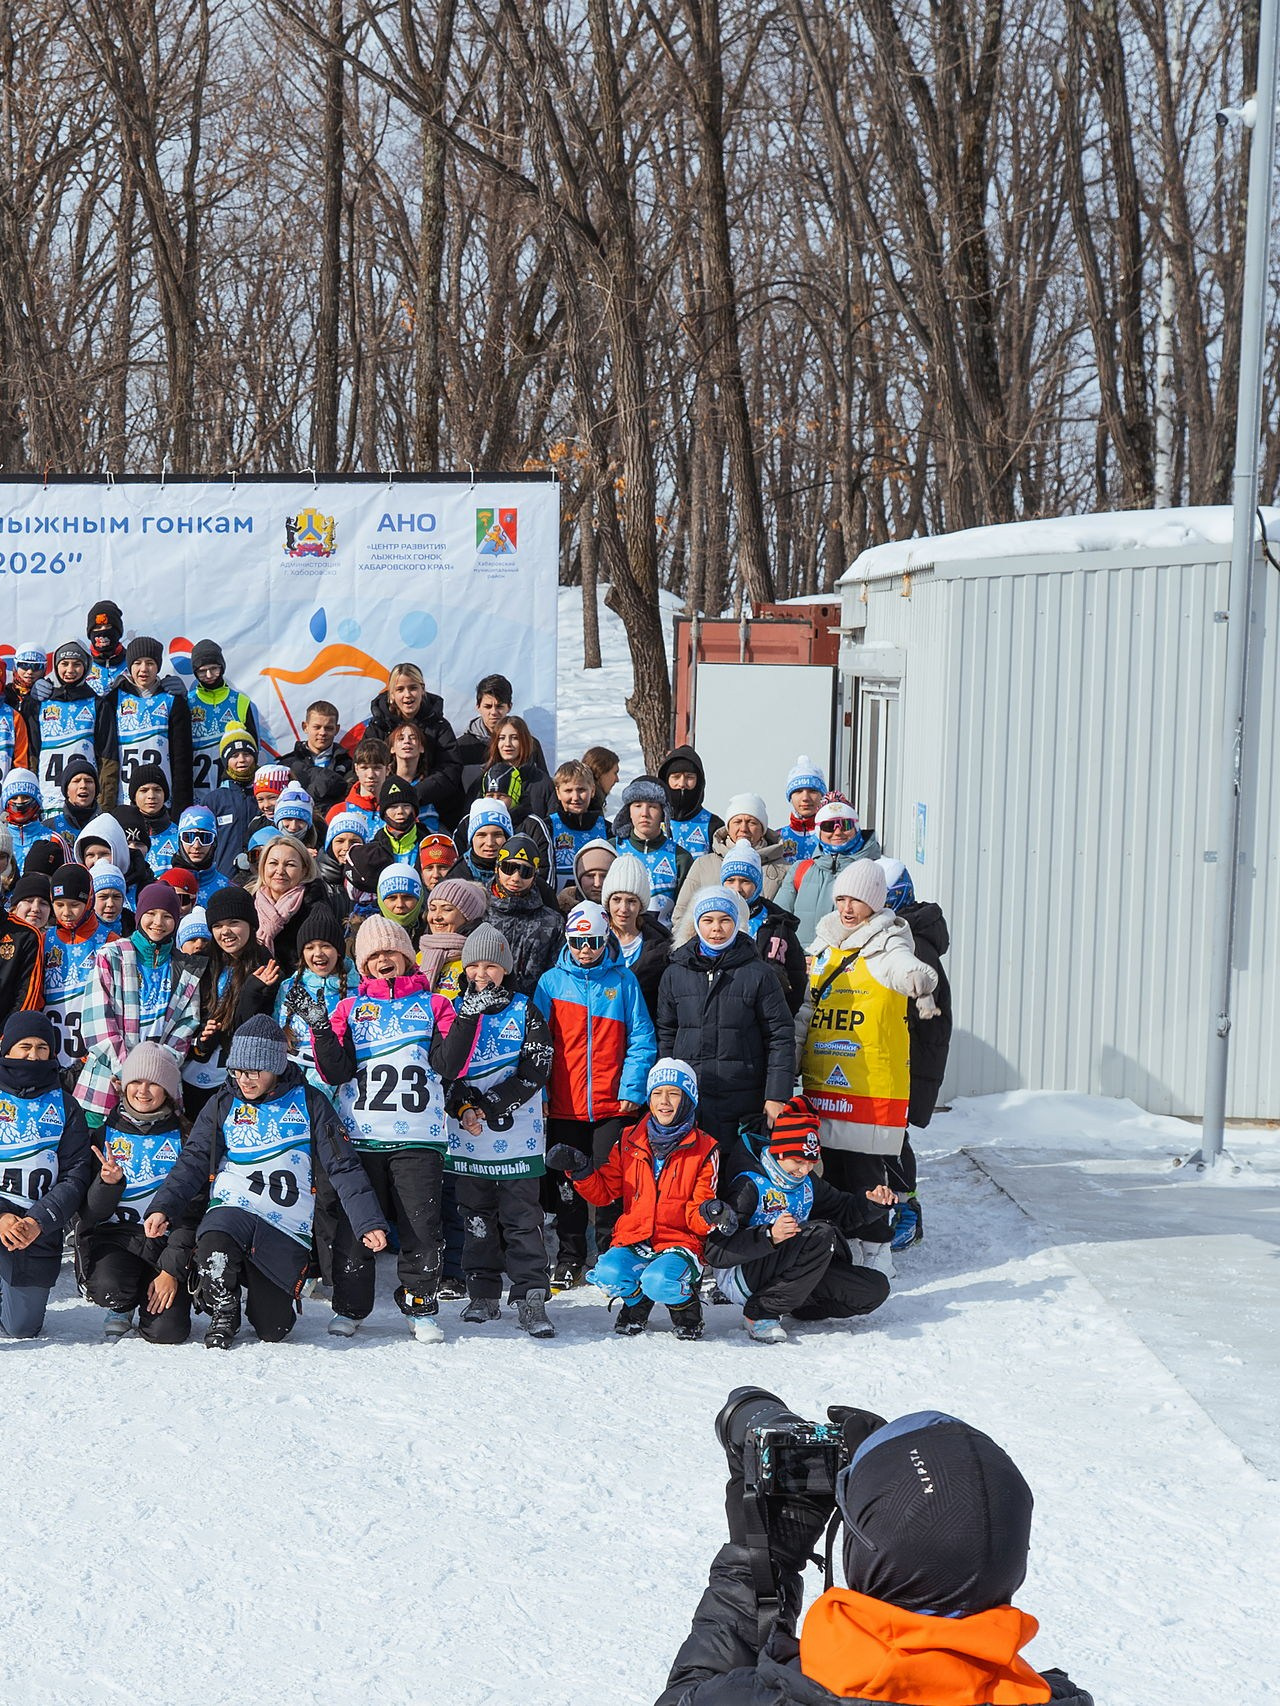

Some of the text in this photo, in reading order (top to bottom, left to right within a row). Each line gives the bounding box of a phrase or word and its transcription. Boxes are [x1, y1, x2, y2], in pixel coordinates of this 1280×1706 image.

[142, 515, 253, 534] гонкам
[376, 513, 437, 532] АНО
[280, 561, 341, 569] Администрация
[370, 553, 442, 561] ЛЫЖНЫХ ГОНОК
[358, 563, 426, 571] ХАБАРОВСКОГО
[45, 754, 87, 787] 4
[768, 936, 788, 965] JR
[810, 1008, 865, 1031] ЕНЕР
[814, 1041, 859, 1053] СТОРОННИКИ
[354, 1063, 431, 1113] 123
[468, 1160, 531, 1176] «НАГОРНЫЙ»
[246, 1170, 300, 1208] 10
[909, 1448, 934, 1494] KIPSTA
